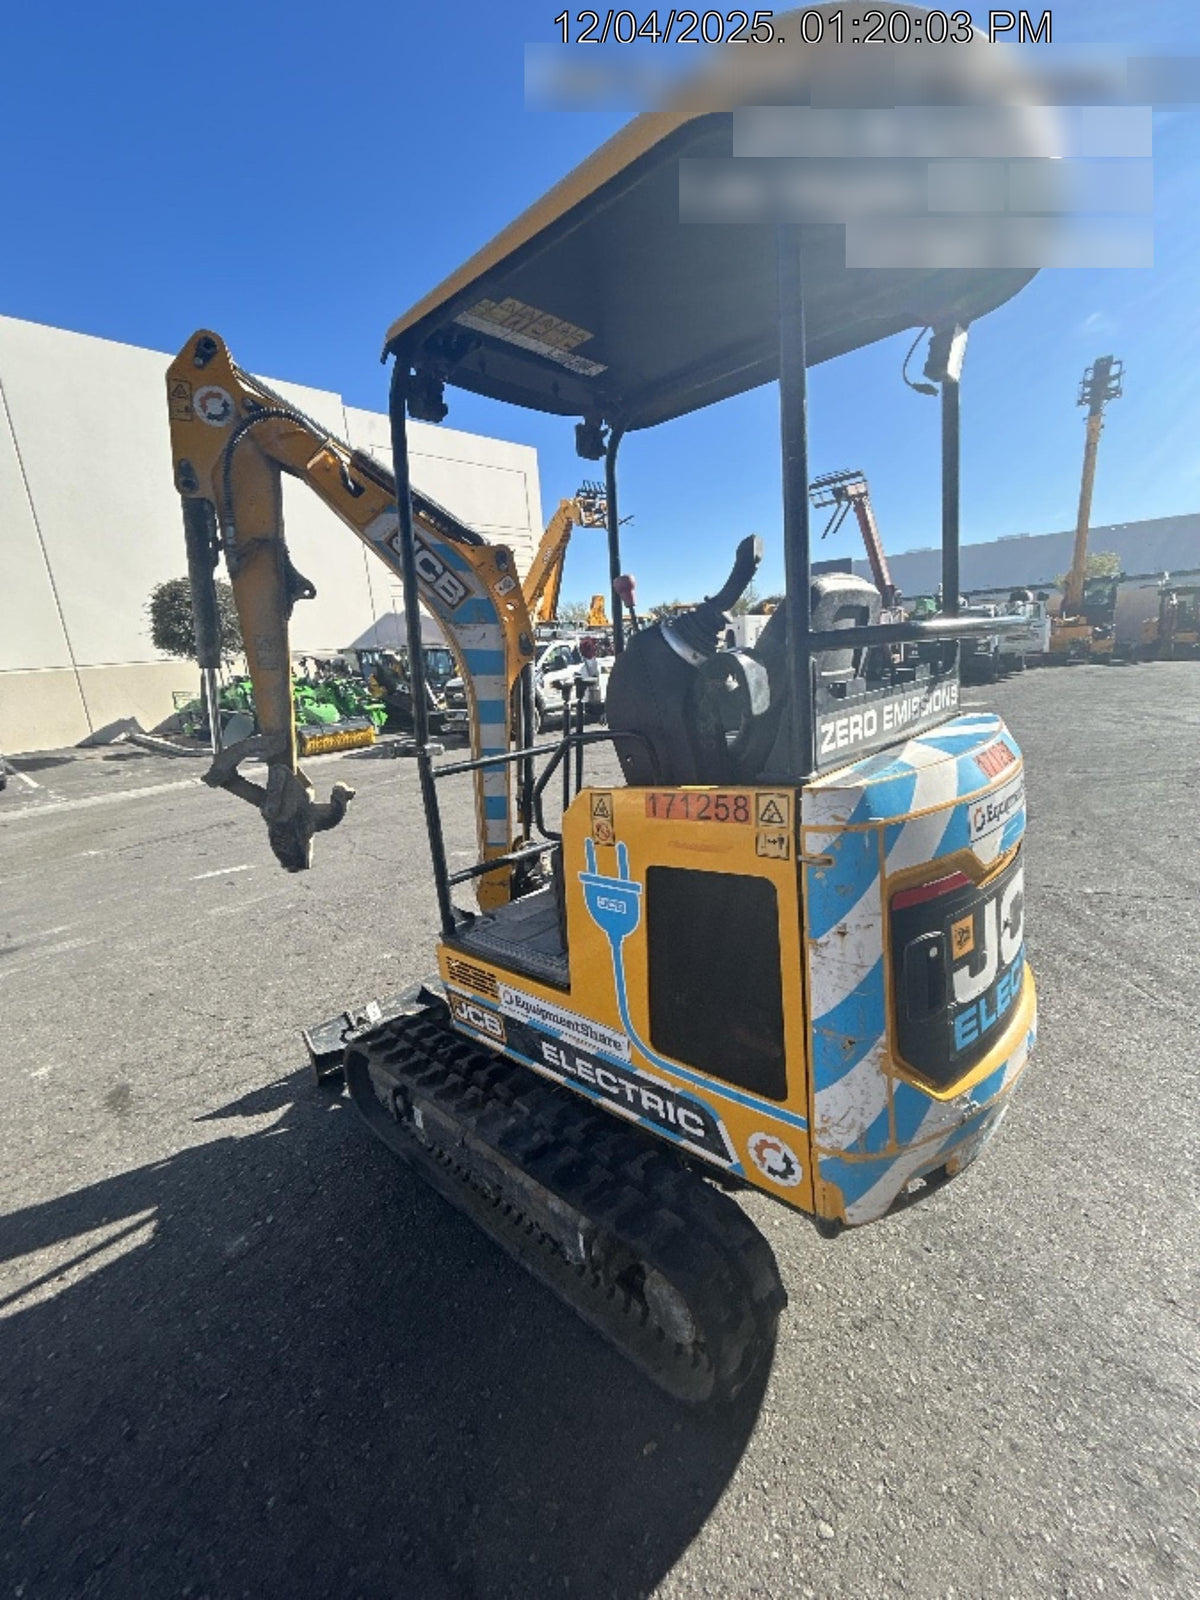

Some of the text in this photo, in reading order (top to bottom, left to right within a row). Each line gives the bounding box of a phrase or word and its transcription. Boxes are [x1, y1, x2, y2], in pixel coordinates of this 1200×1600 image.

[821, 684, 958, 754] ZERO EMISSIONS
[648, 794, 749, 822] 171258
[455, 1002, 501, 1034] JCB
[514, 994, 623, 1052] EquipmentShare
[541, 1041, 705, 1137] ELECTRIC
